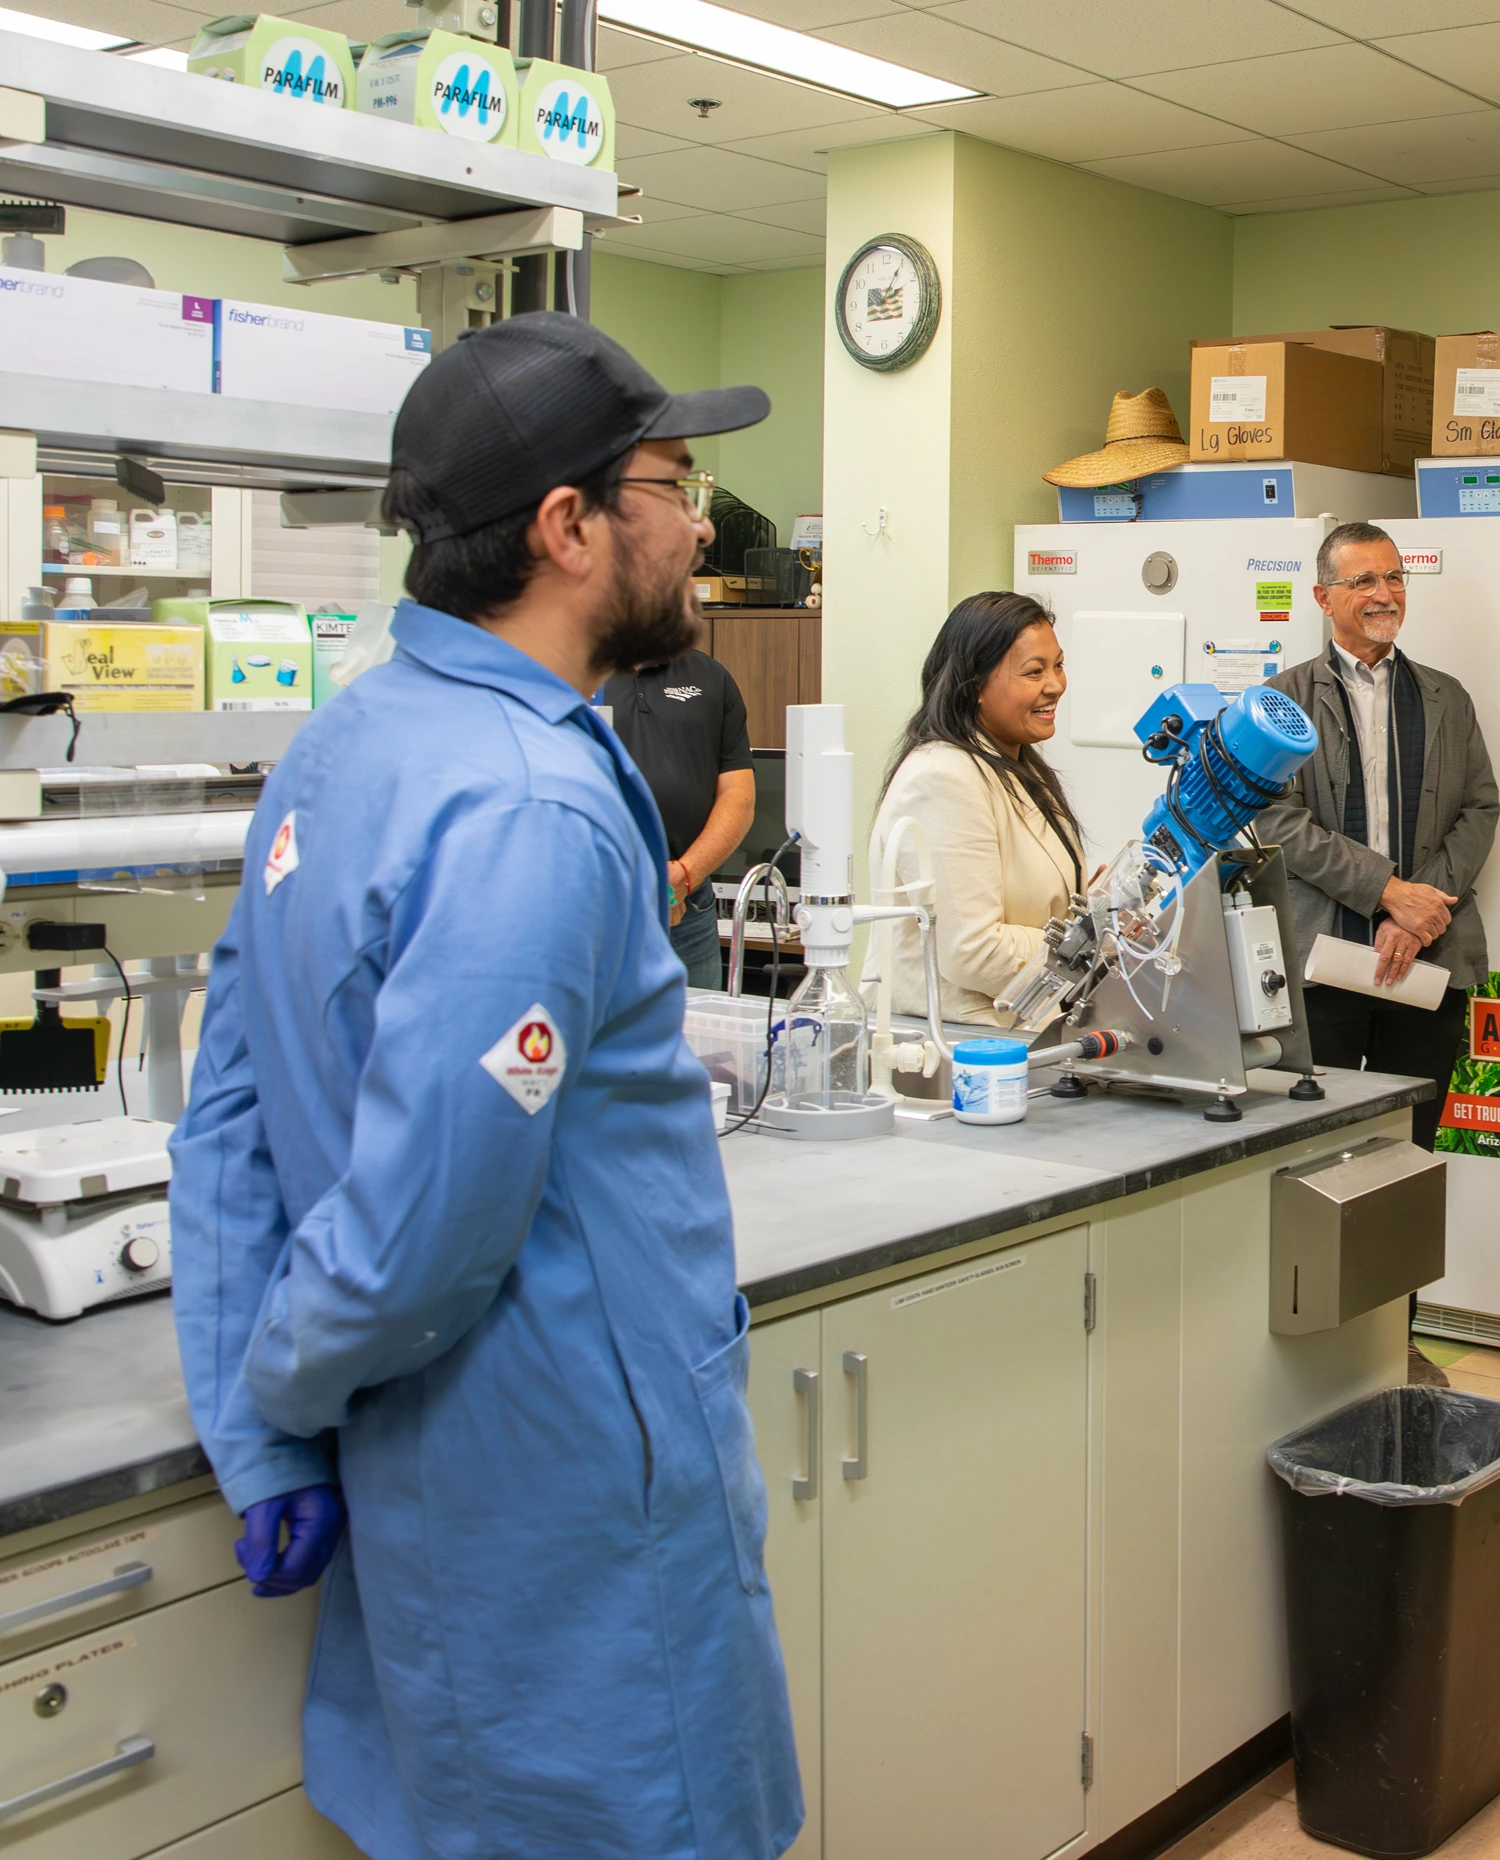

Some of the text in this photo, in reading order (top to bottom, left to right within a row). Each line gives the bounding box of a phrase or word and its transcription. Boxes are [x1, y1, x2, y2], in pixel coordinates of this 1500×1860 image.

[264, 67, 339, 99] PARAFILM
[434, 82, 502, 113] PARAFILM
[537, 108, 599, 136] PARAFILM
[882, 255, 892, 265] 12
[866, 263, 875, 274] 11
[855, 279, 866, 290] 10
[850, 301, 858, 311] 9
[229, 309, 305, 332] fisherbrand
[855, 322, 862, 332] 8
[866, 336, 872, 345] 7
[897, 332, 904, 342] 5
[881, 340, 888, 350] 6
[1446, 421, 1473, 442] Sm
[1201, 426, 1273, 453] Lg Gloves
[1030, 554, 1074, 566] Thermo
[92, 666, 135, 681] View
[1454, 1103, 1474, 1120] GET
[55, 1641, 124, 1671] PLATES
